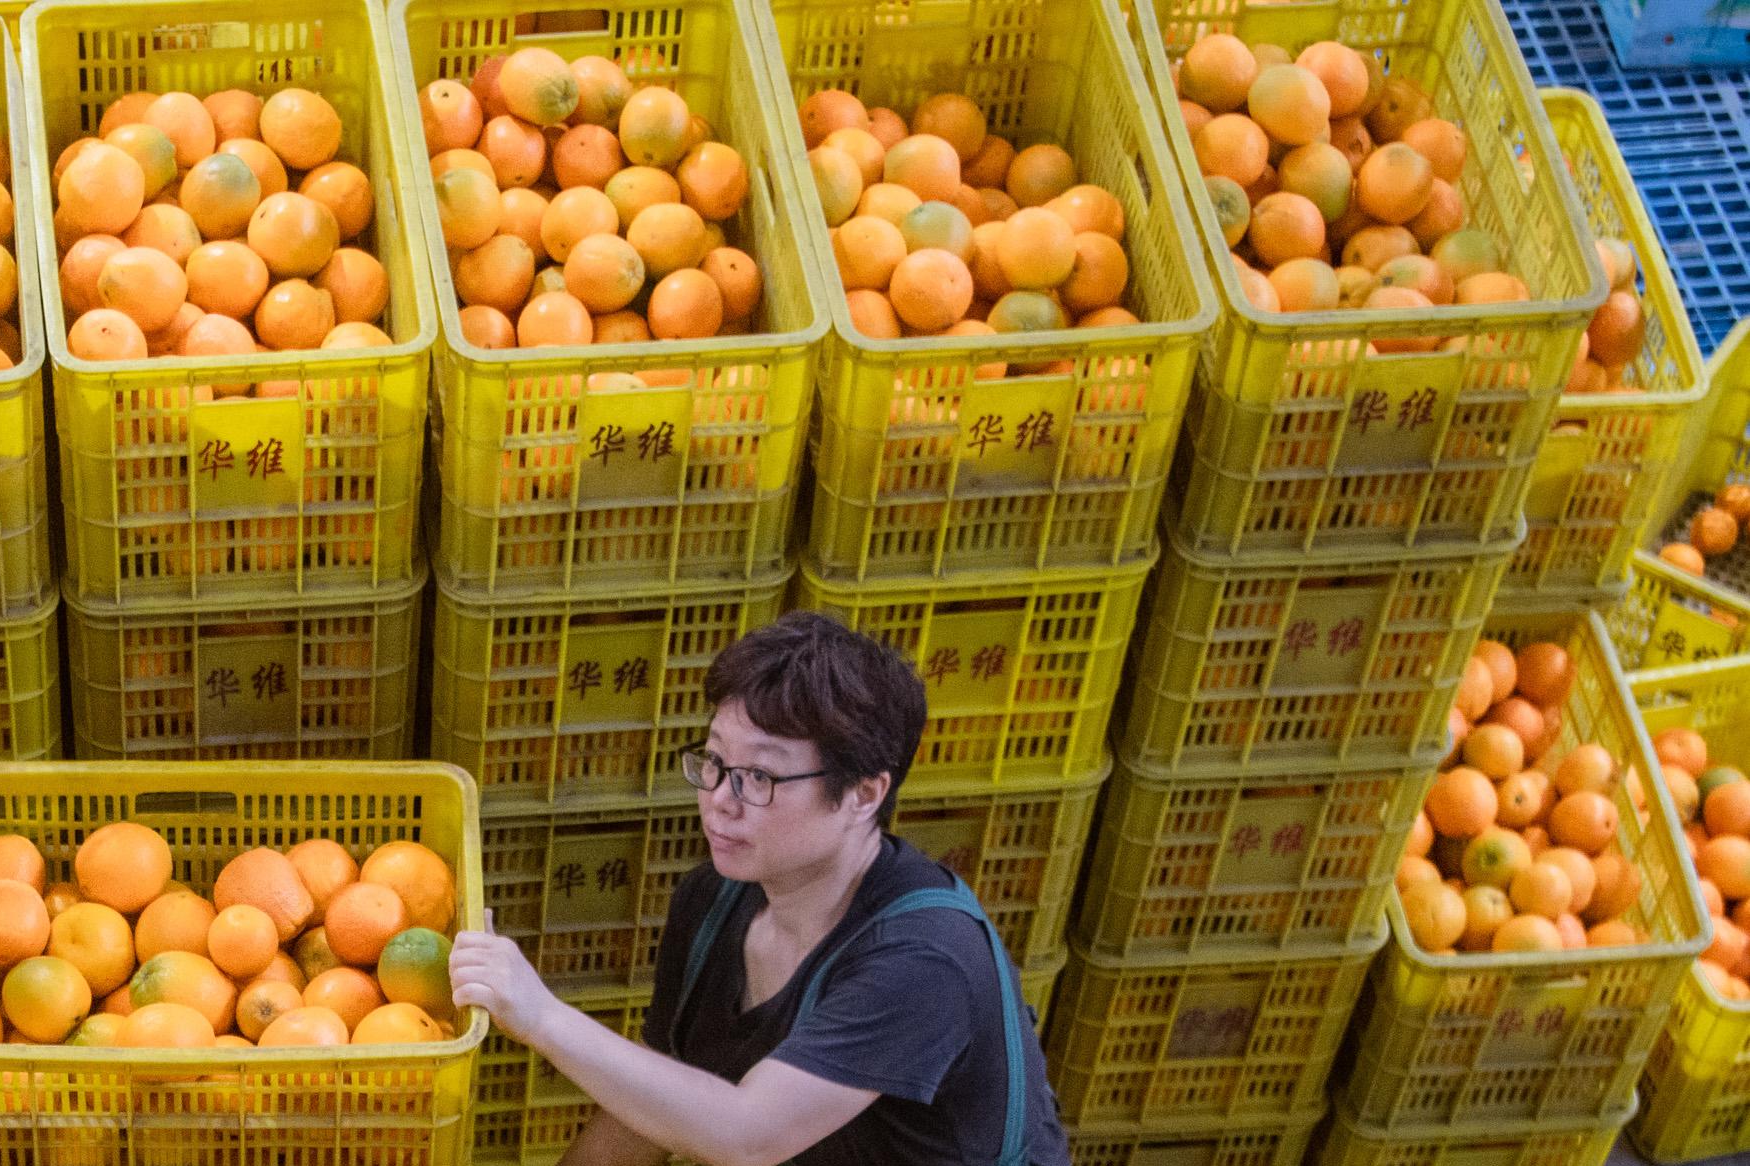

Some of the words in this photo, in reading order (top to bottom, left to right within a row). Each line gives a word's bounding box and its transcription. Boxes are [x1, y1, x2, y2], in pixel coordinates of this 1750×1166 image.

[967, 409, 1055, 458] 华维
[1352, 387, 1438, 434] 华维
[197, 437, 285, 481] 华维
[589, 420, 677, 467] 华维
[206, 660, 291, 708] 华维
[569, 656, 652, 702] 华维
